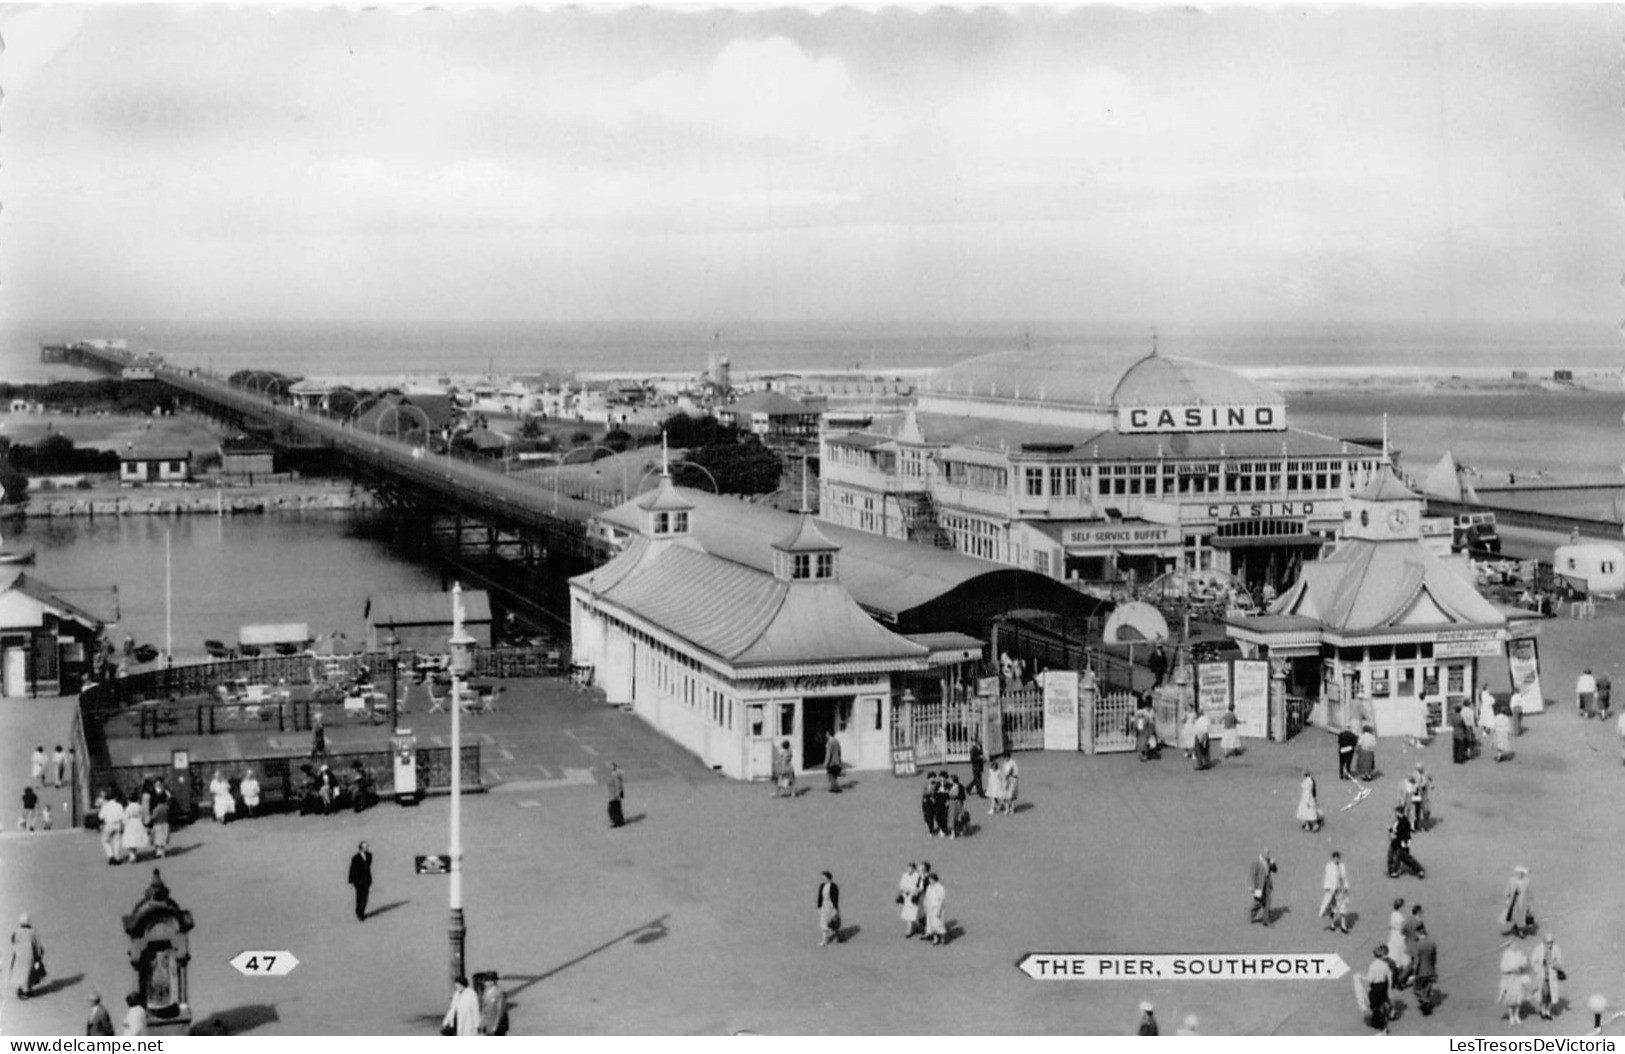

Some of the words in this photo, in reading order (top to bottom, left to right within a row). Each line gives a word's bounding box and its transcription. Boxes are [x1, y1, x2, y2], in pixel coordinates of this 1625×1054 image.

[1131, 407, 1273, 428] CASINO
[1208, 502, 1314, 518] CASINO
[1134, 529, 1168, 541] BUFFET
